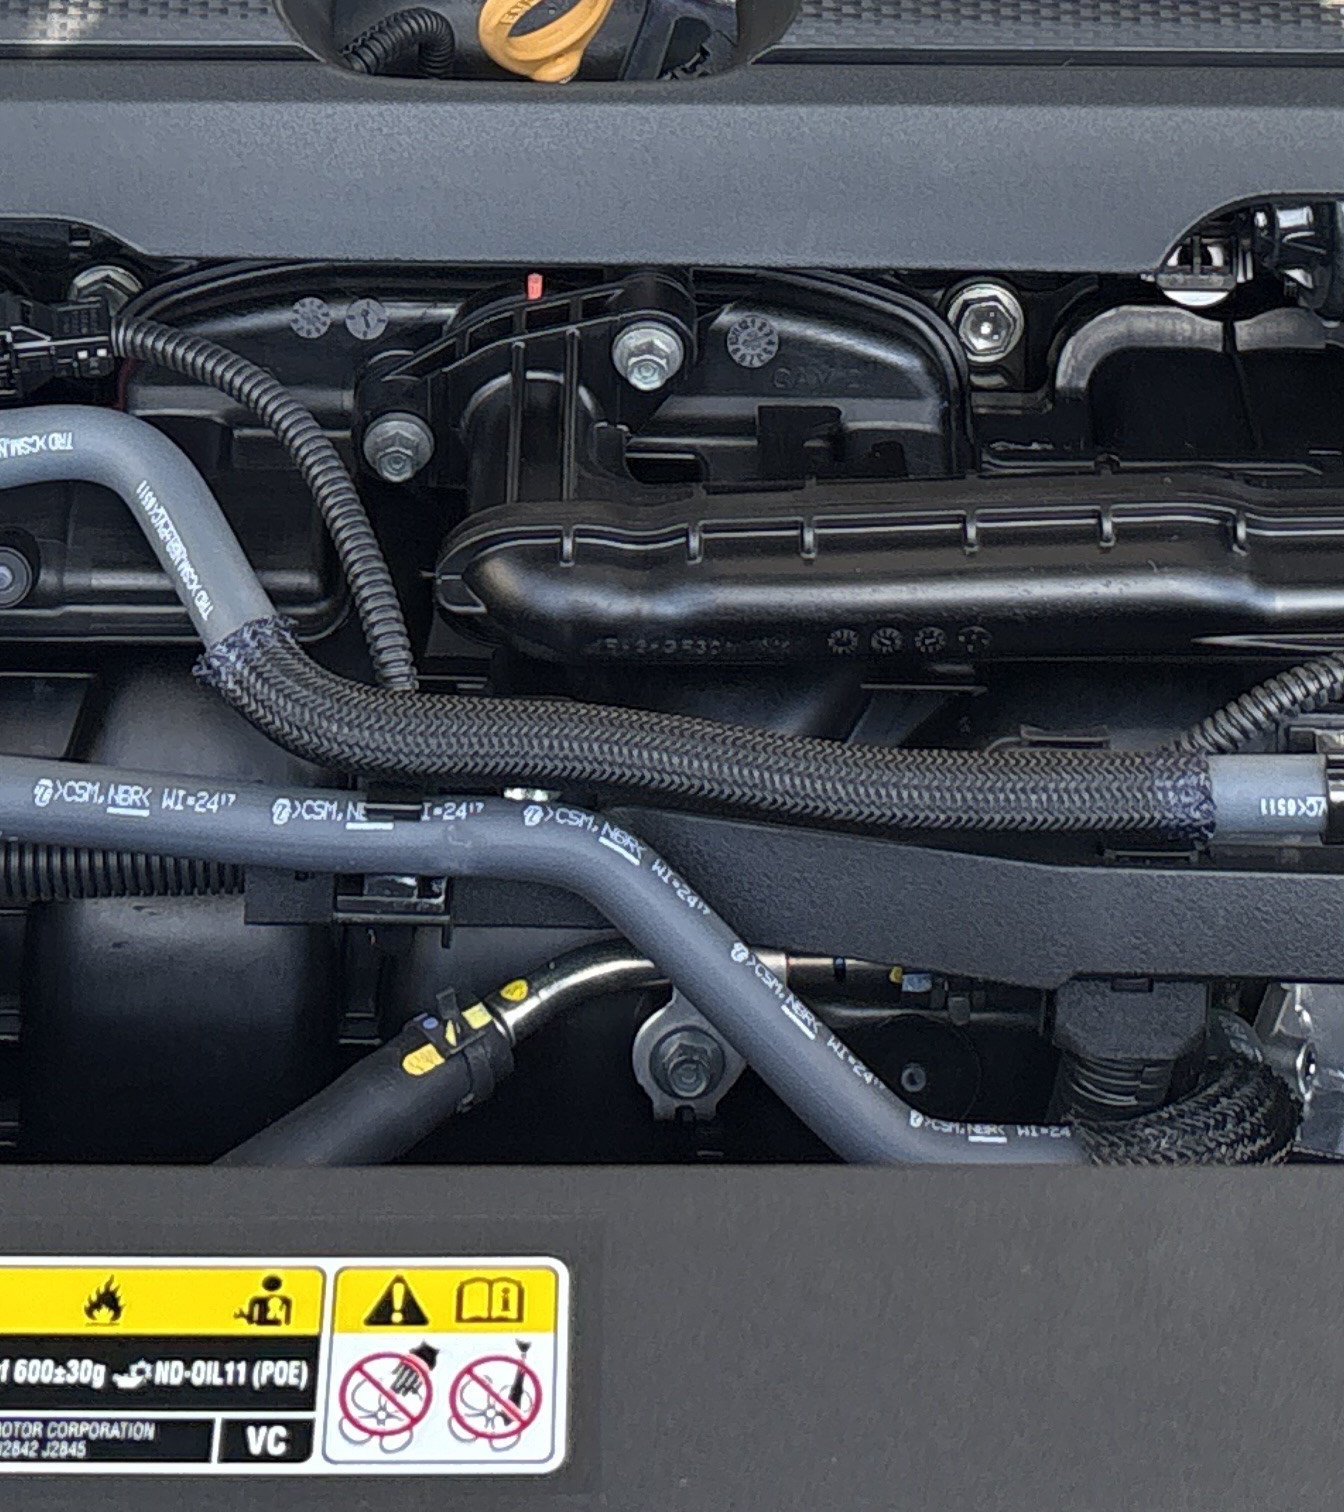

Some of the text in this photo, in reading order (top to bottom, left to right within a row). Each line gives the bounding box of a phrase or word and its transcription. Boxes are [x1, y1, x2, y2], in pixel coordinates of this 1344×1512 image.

[13, 1358, 107, 1390] 600±30g
[154, 1359, 247, 1387] ND-OIL11
[252, 1360, 309, 1391] (POE)
[46, 1420, 156, 1441] CORPORATION
[247, 1425, 287, 1458] VC
[40, 1440, 87, 1459] J2845
